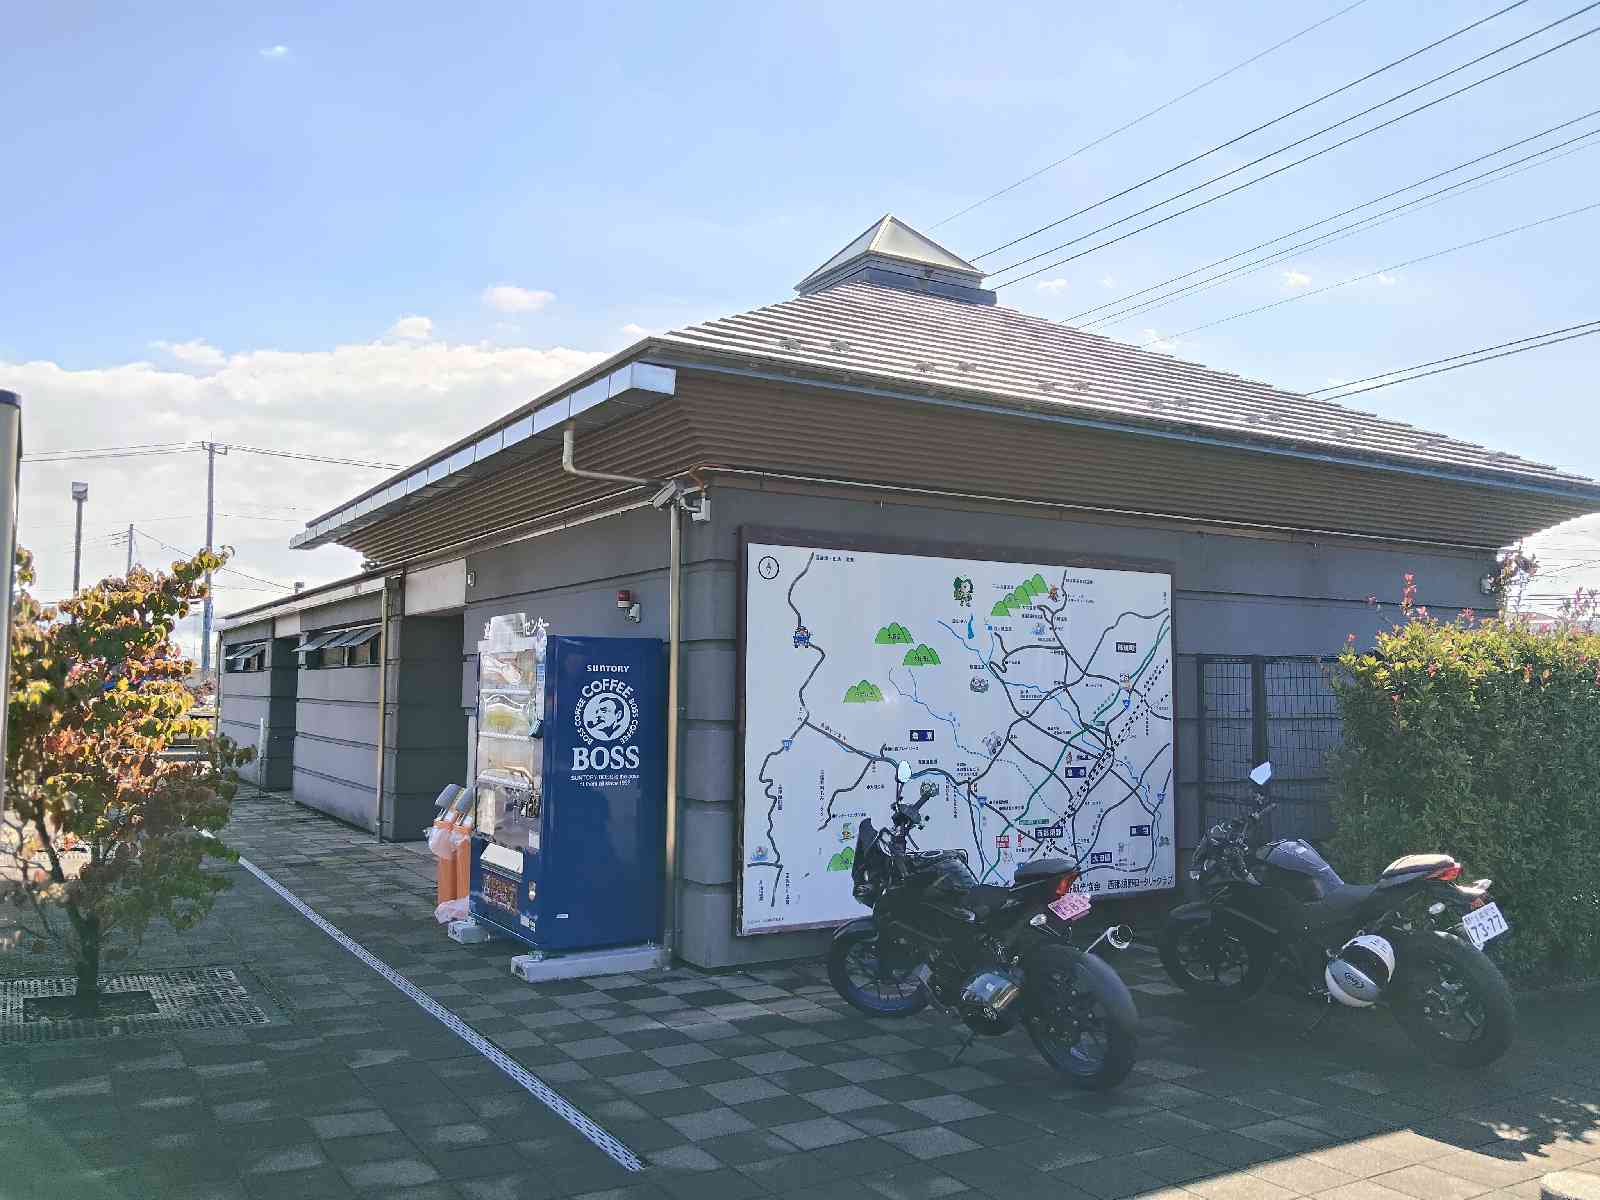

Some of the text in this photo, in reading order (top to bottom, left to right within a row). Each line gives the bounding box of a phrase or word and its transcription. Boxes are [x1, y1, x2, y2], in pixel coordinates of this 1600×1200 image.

[586, 664, 630, 673] SUNTORY
[581, 678, 634, 698] COFFEE
[629, 698, 639, 718] BOSS
[577, 727, 594, 745] BOSS
[571, 745, 640, 771] BOSS
